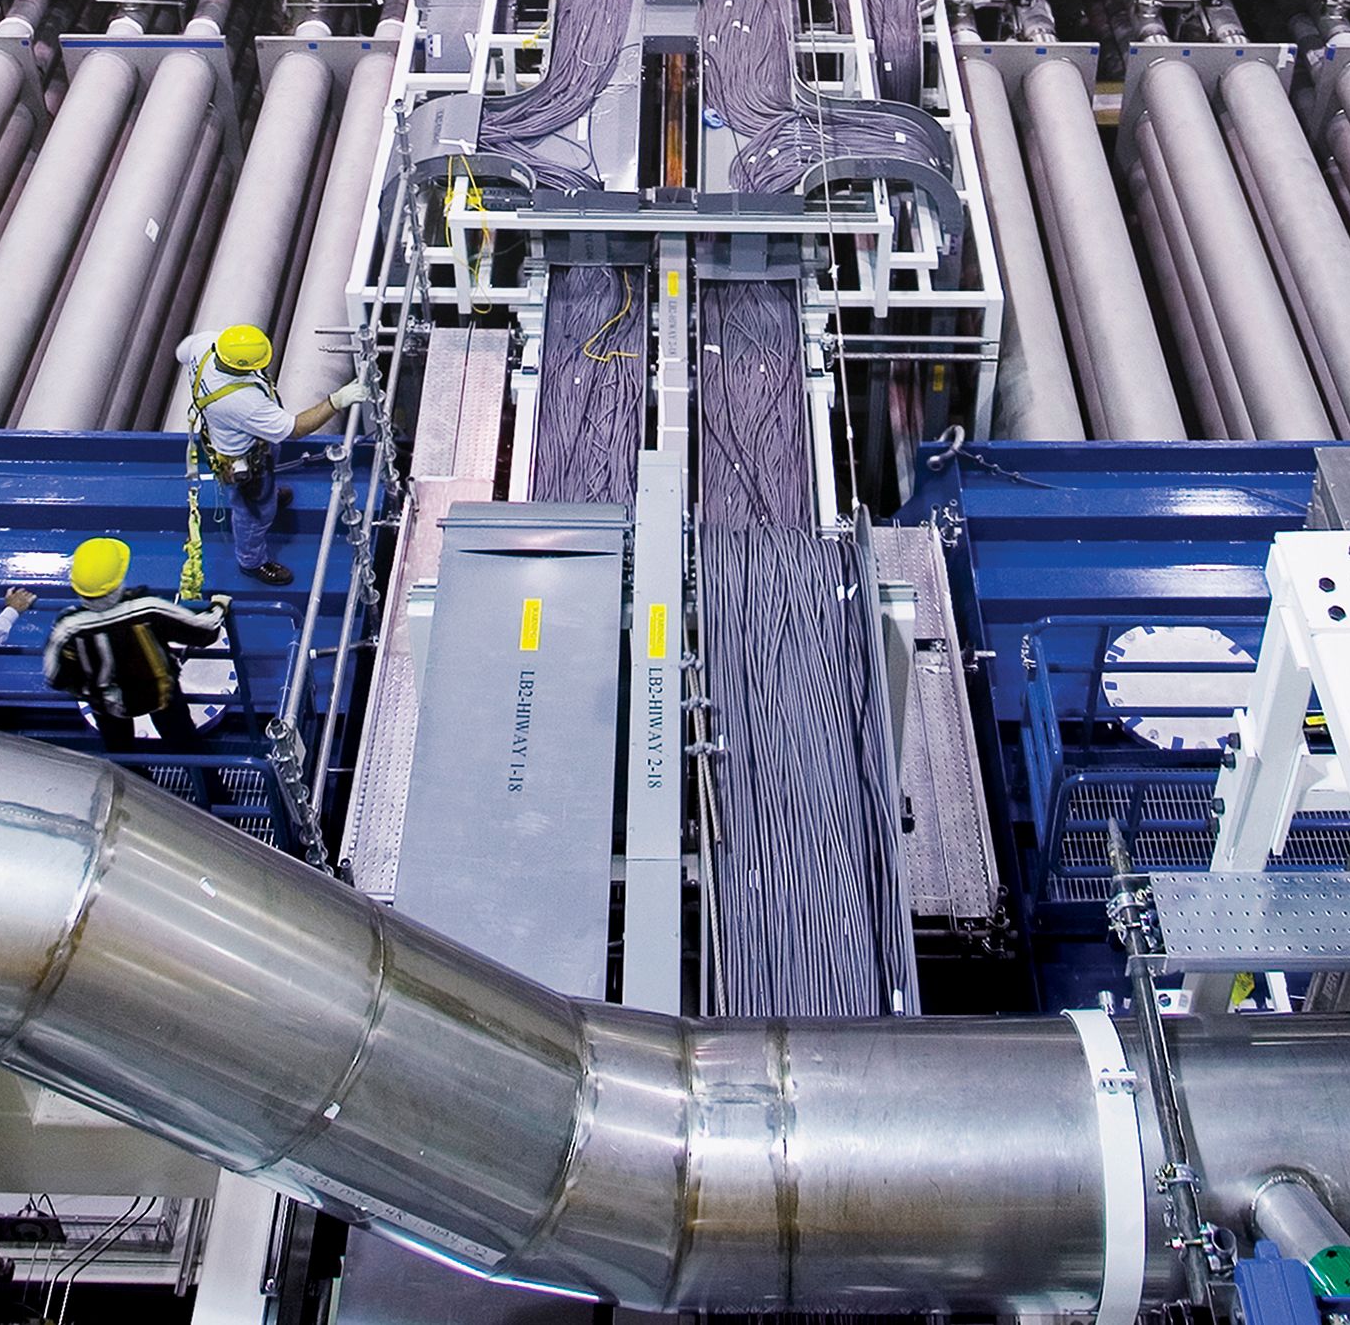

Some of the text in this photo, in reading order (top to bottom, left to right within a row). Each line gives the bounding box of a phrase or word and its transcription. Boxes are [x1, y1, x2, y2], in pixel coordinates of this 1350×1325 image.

[508, 670, 535, 793] LB2-HIWAY 1-18
[647, 667, 663, 789] LB2-HIWAY 2-18
